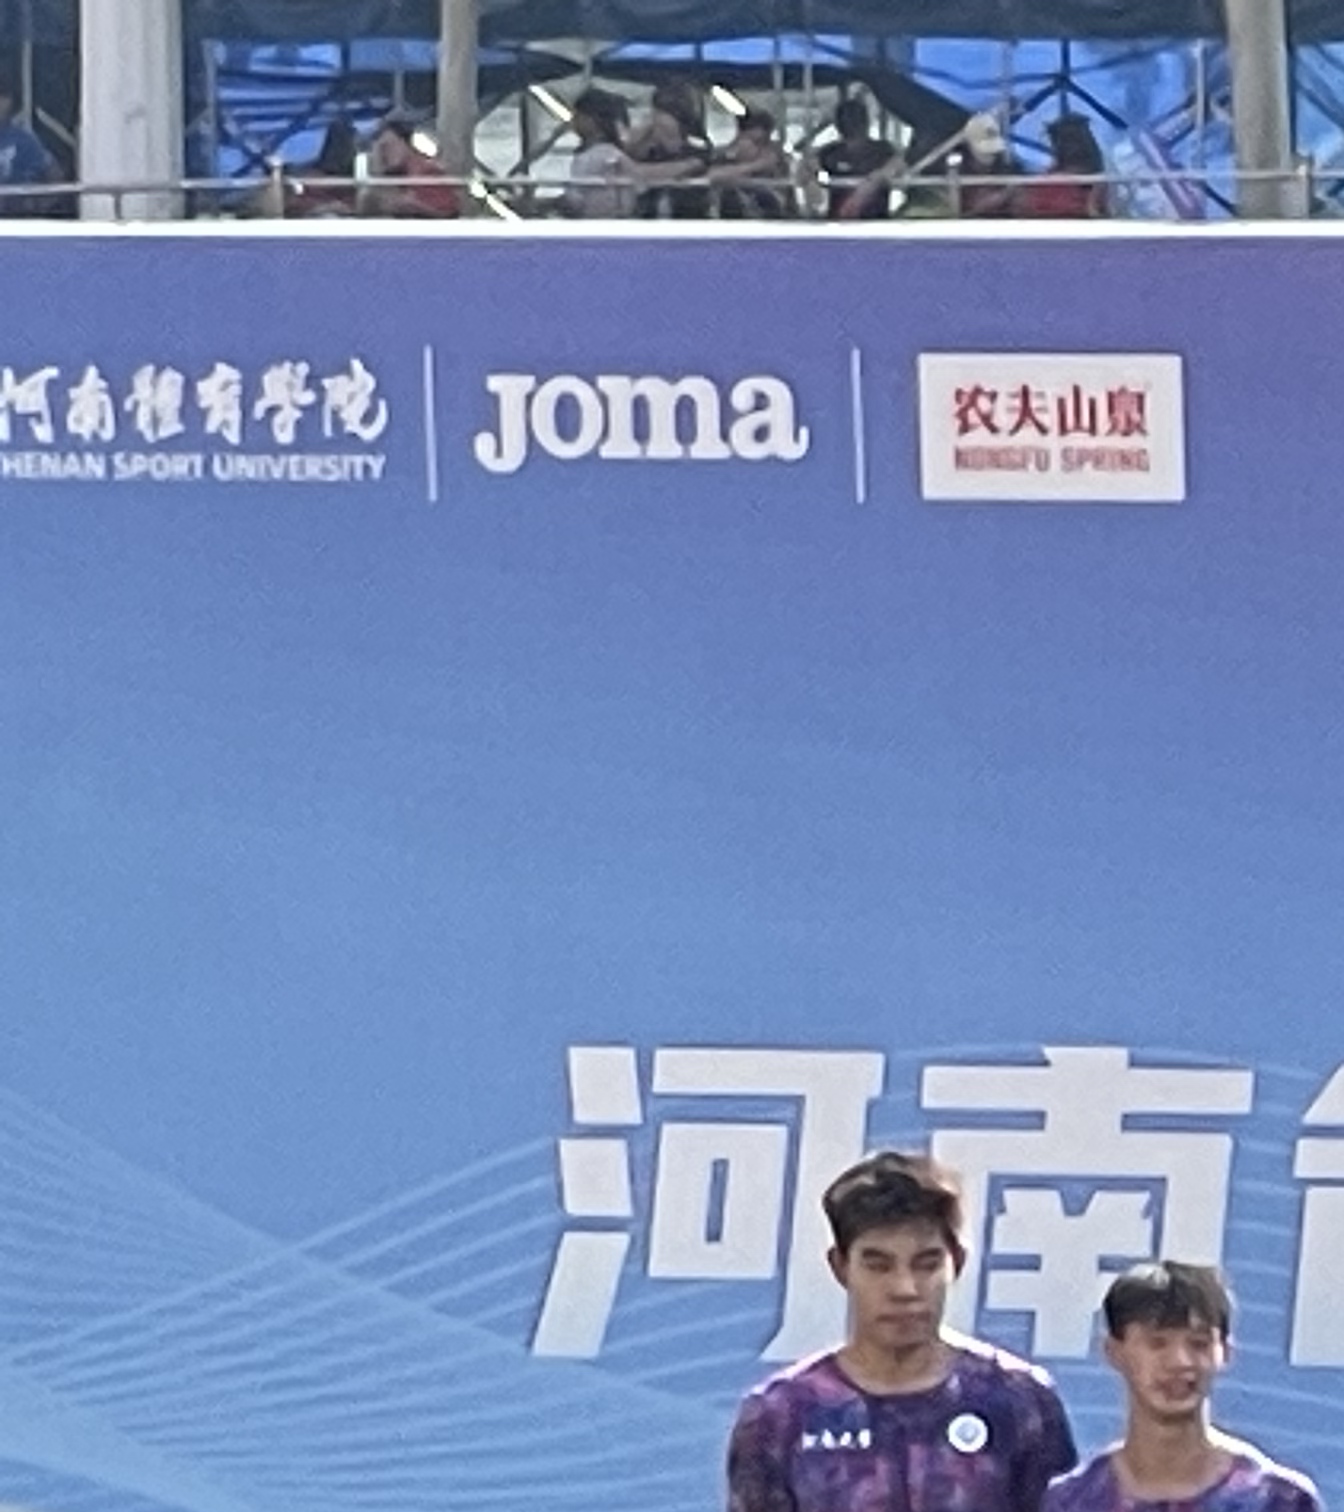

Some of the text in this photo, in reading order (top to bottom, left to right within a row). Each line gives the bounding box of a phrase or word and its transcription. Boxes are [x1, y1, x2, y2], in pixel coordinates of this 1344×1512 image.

[954, 384, 1149, 437] 农夫山泉
[1, 452, 386, 481] HENAN SPORT UNIVERSITY
